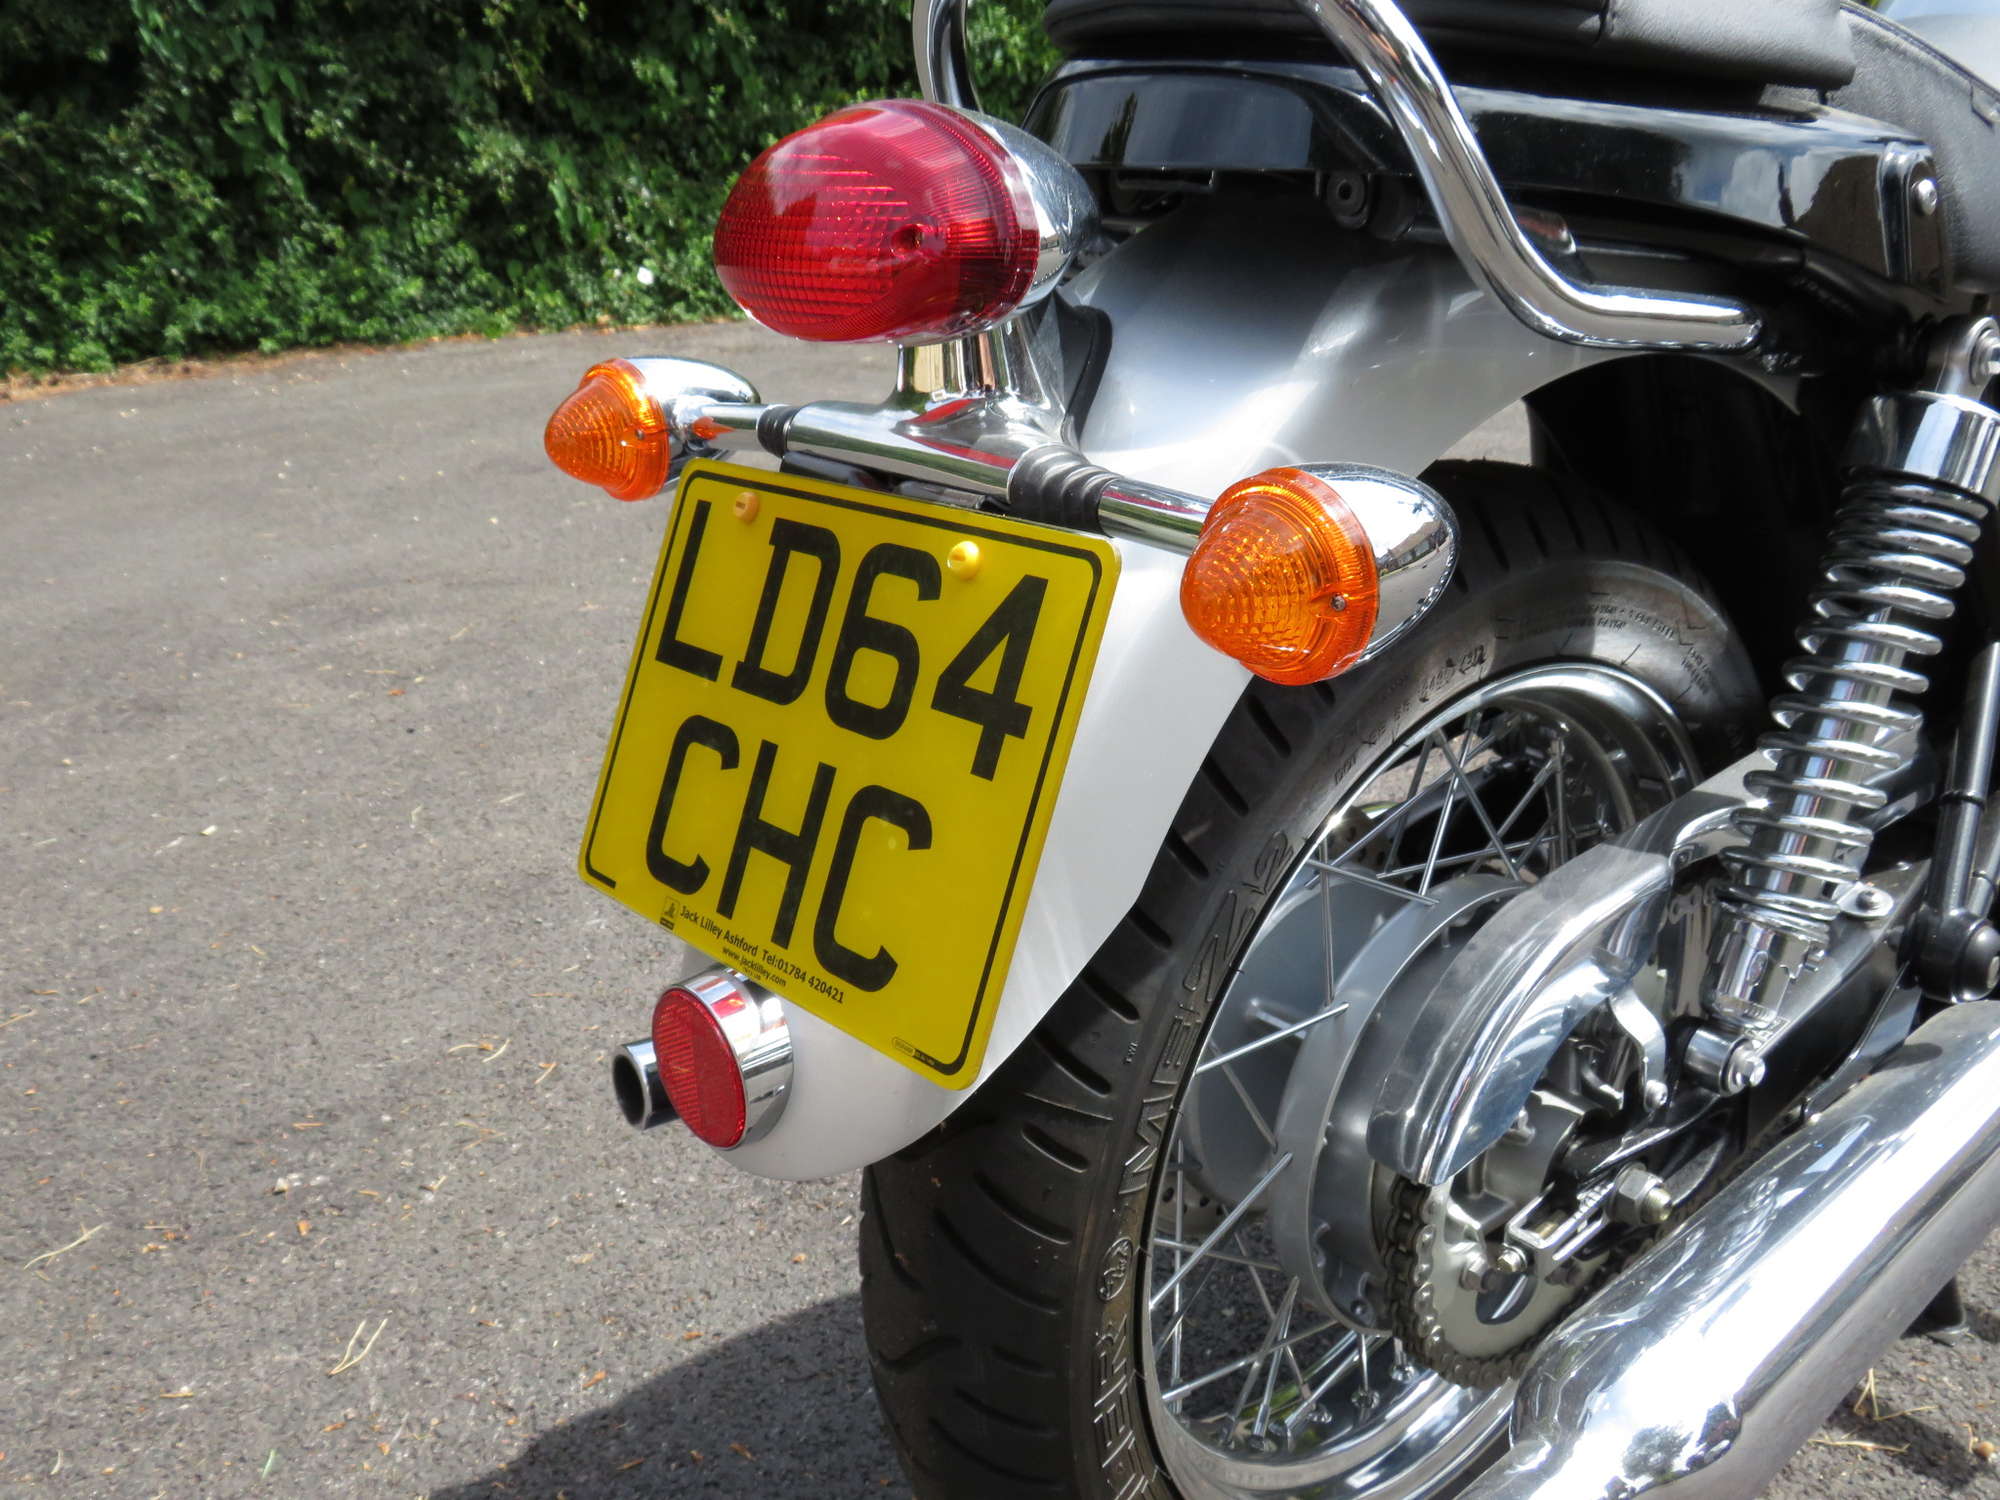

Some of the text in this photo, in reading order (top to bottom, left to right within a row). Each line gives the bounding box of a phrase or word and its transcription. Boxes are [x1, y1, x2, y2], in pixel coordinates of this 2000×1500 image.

[654, 499, 1049, 782] LD64
[645, 714, 933, 993] CHC
[680, 905, 699, 923] Jack
[700, 916, 722, 940] Lilley
[723, 929, 759, 957] Ashford
[762, 949, 806, 982] Tel:01784
[808, 976, 845, 1004] 420421
[722, 947, 787, 987] www.jacklilley.com
